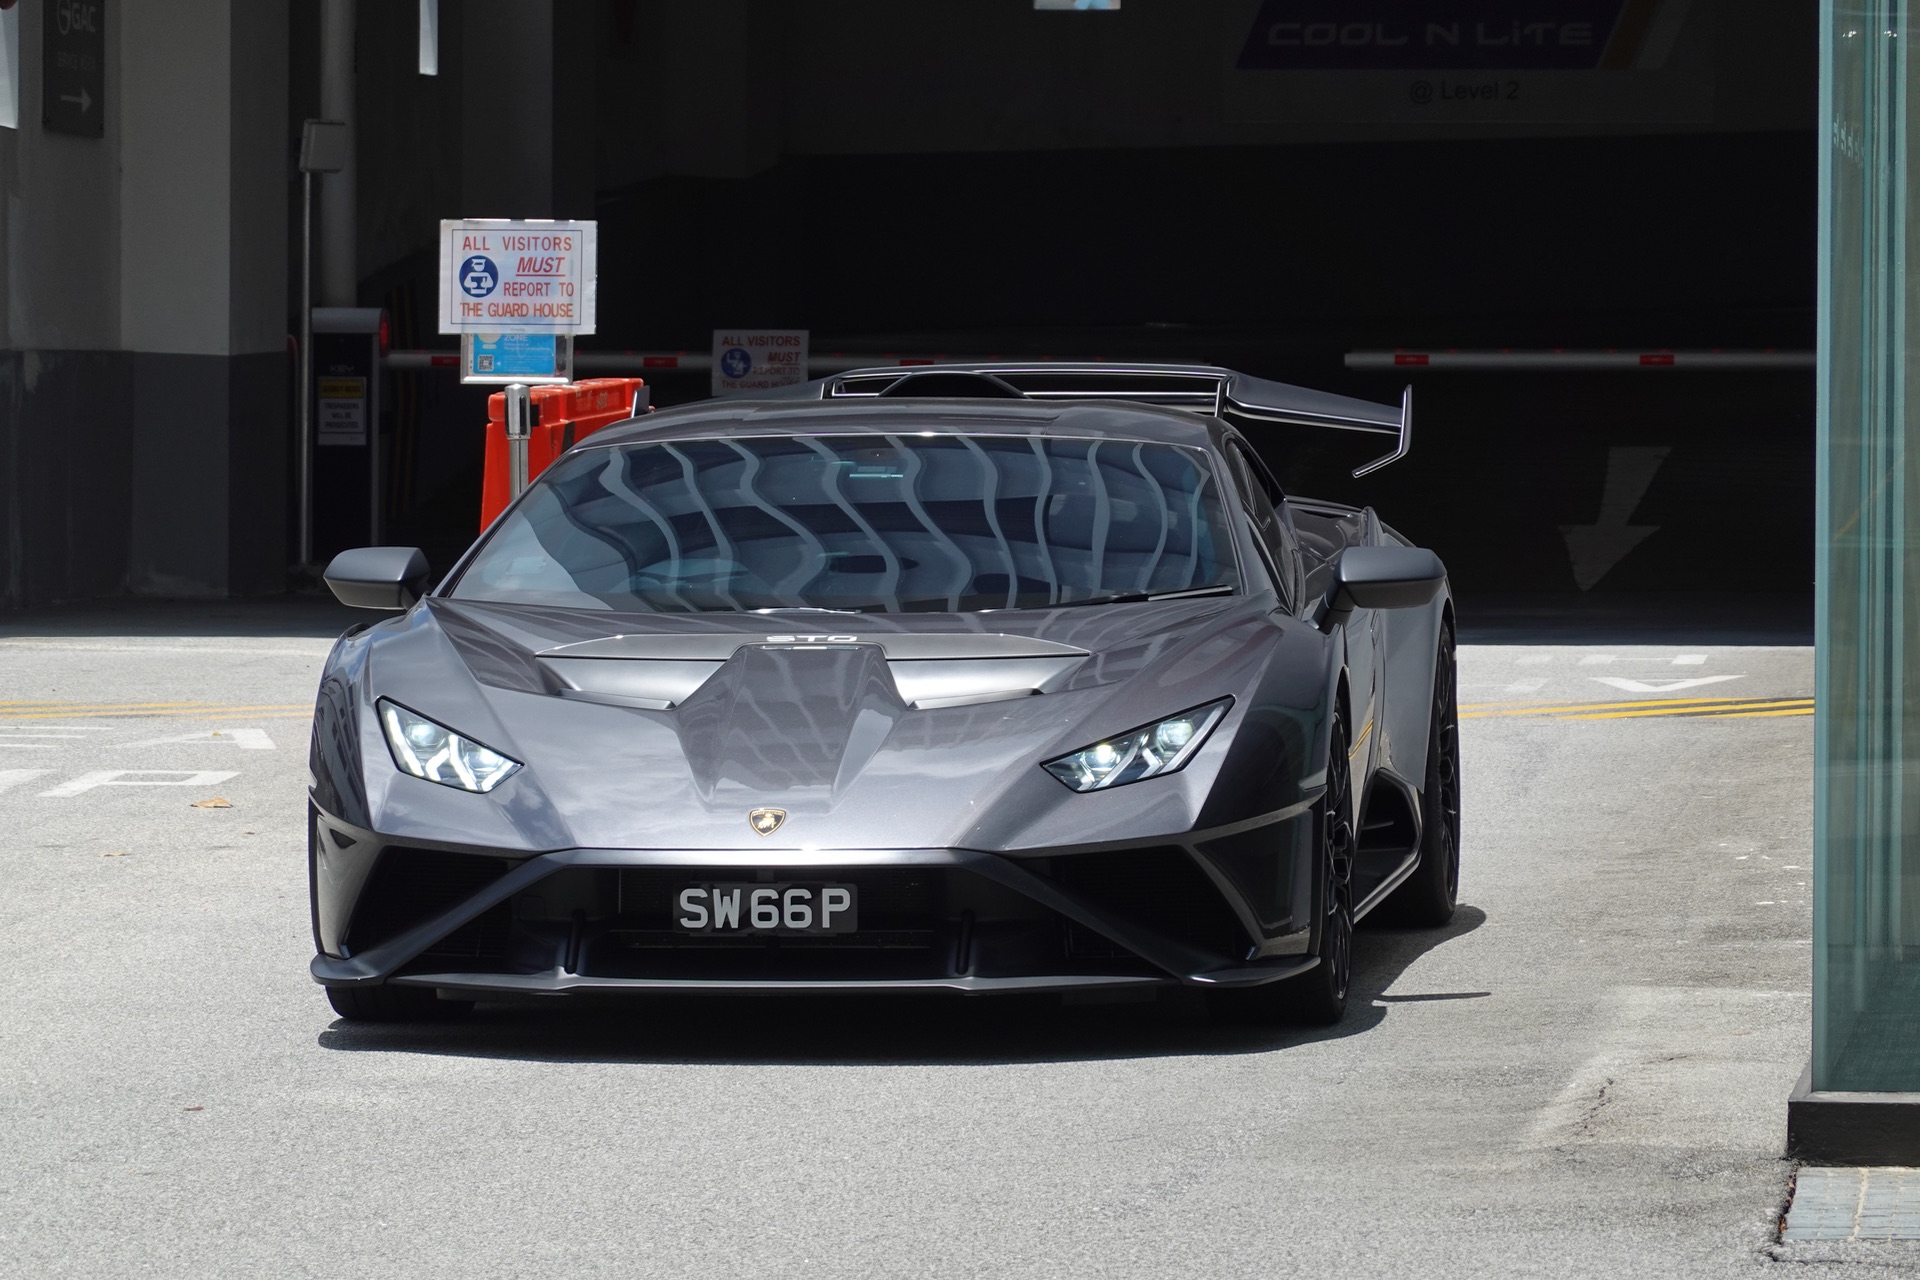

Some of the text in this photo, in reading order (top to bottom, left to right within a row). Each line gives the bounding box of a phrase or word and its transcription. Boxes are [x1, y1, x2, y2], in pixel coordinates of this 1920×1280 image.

[1267, 22, 1408, 46] COOL
[1425, 22, 1459, 46] N
[1440, 81, 1499, 100] Level
[1507, 81, 1519, 100] 2
[462, 236, 572, 251] ALL VISITORS
[517, 256, 565, 273] MUST
[503, 281, 574, 297] REPORT TO
[460, 302, 574, 318] THE GUARD HOUSE
[504, 334, 528, 342] ZONE
[722, 335, 801, 347] ALL VISITORS
[767, 351, 802, 363] MUST
[721, 380, 737, 389] THE
[739, 380, 769, 389] GUARD
[679, 888, 851, 929] SW66P
